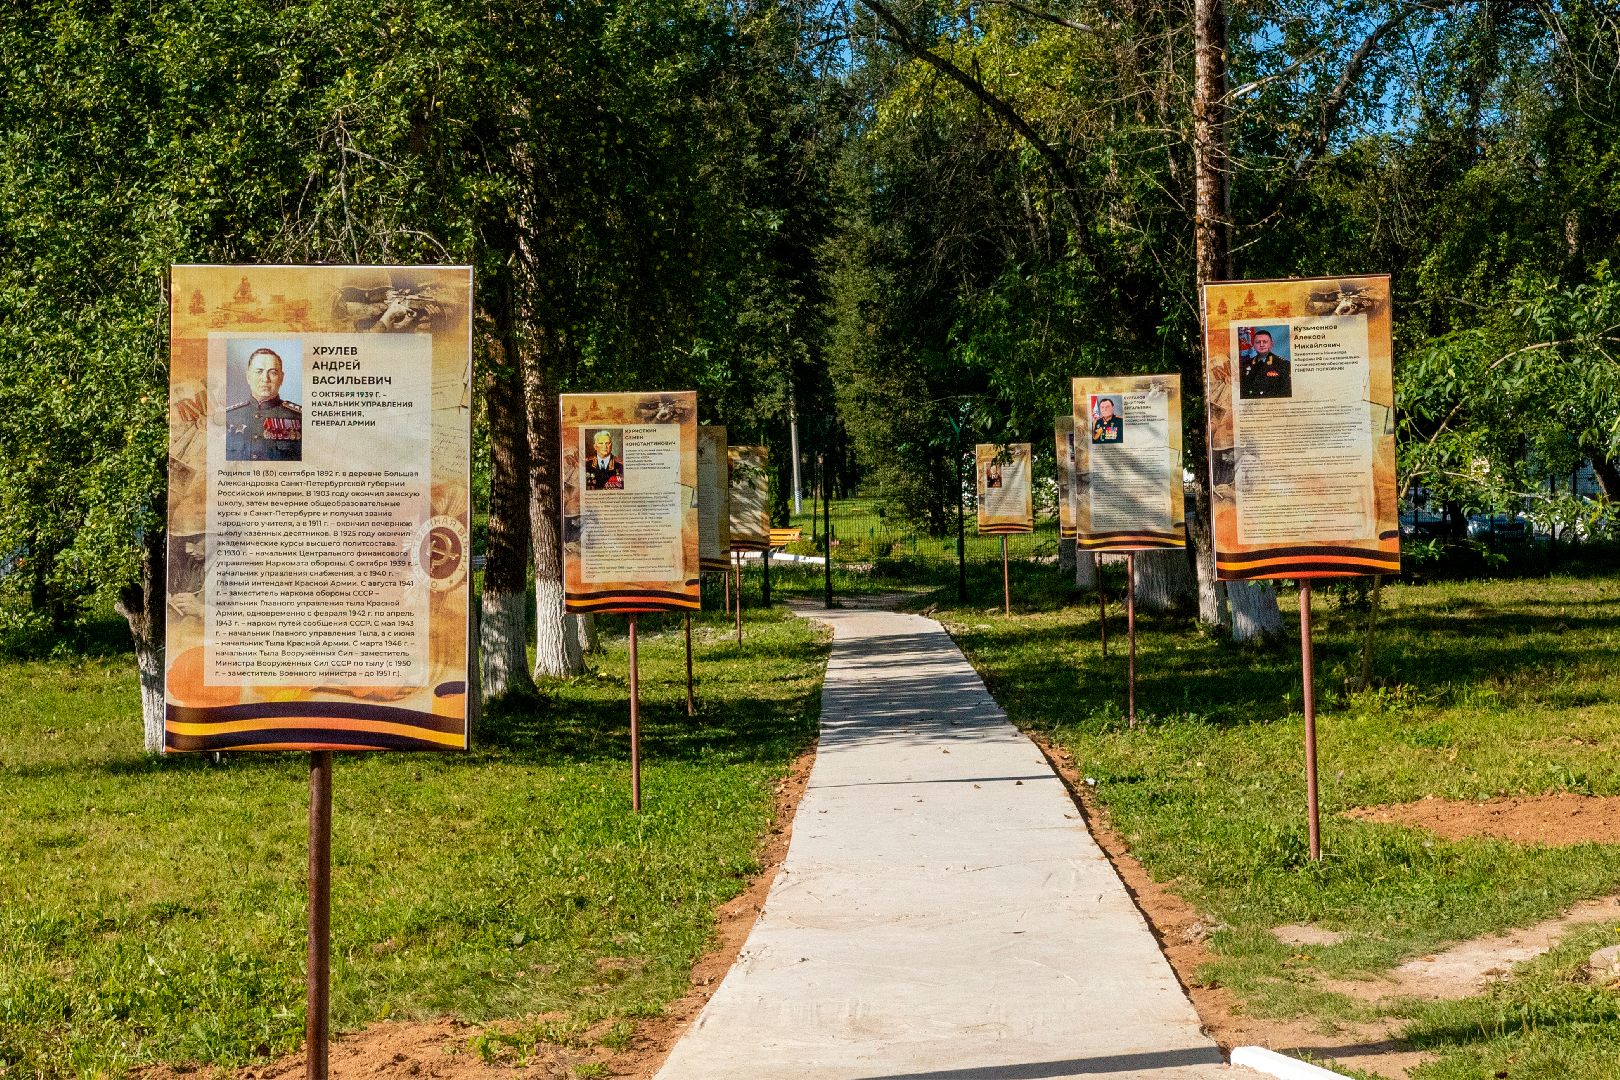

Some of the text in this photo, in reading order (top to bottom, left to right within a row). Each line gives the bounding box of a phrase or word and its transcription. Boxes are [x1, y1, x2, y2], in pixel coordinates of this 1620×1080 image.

[312, 346, 358, 356] ХРУЛЕВ
[312, 360, 360, 371] АНДРЕЙ
[312, 376, 392, 385] ВАСИЛЬЕВИЧ
[262, 470, 277, 478] (30)
[278, 470, 315, 478] сентября
[217, 480, 406, 488] Александровка Санкт-Петербургской губернии
[310, 500, 401, 508] общеобразовательные
[249, 510, 321, 518] Санкт-Петербурге
[299, 550, 355, 558] Центрального
[356, 549, 408, 558] финансового
[265, 560, 309, 568] Наркомата
[310, 560, 347, 568] обороны.
[356, 560, 388, 568] октября
[294, 580, 328, 588] Красной
[330, 580, 359, 588] Армии.
[315, 590, 351, 598] обороны
[366, 600, 400, 608] Красной
[215, 610, 245, 618] Армии,
[313, 609, 348, 618] февраля
[278, 620, 301, 628] путей
[286, 640, 320, 648] Красной
[322, 640, 351, 648] Армии.
[215, 660, 255, 668] Министра
